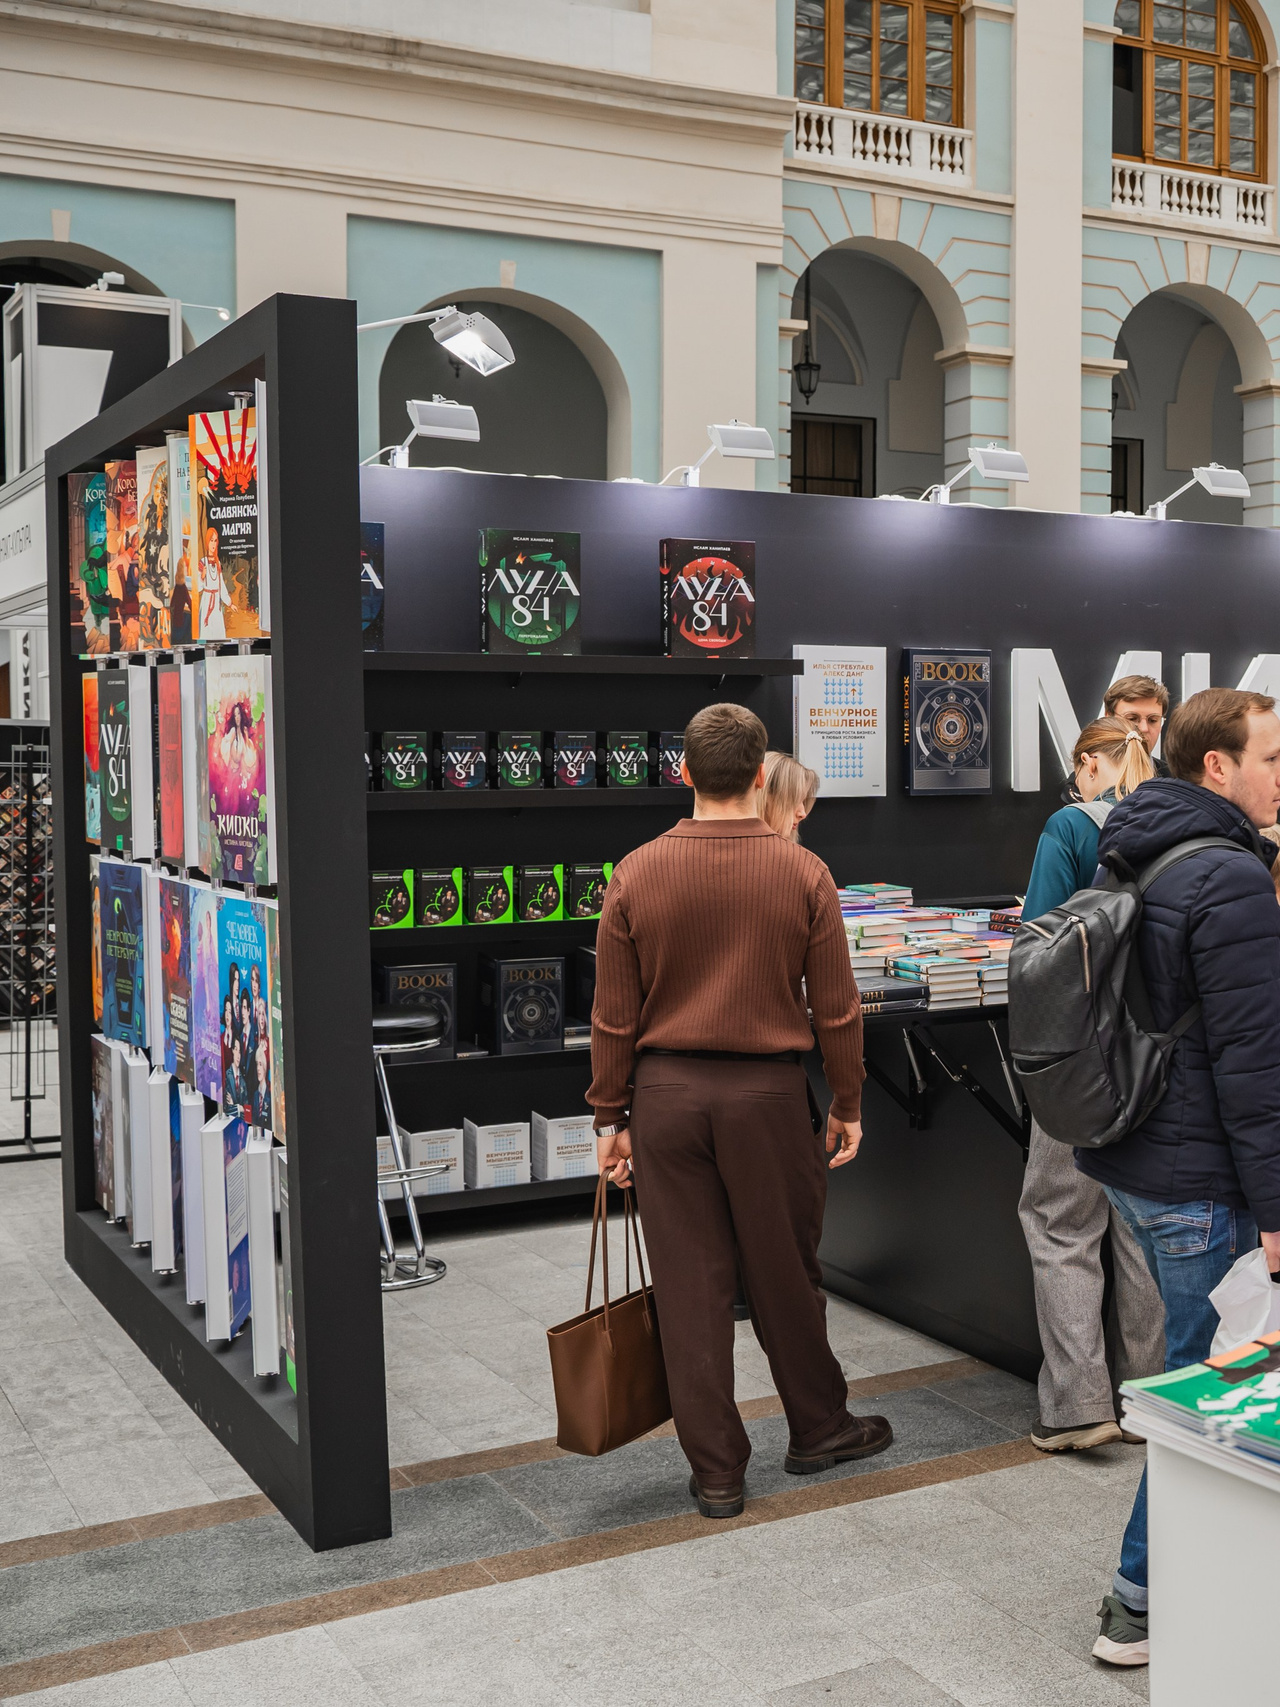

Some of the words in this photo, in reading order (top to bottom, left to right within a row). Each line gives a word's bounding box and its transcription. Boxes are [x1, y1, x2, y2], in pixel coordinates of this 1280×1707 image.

[210, 504, 258, 520] СЛАВЯНСКА
[488, 568, 580, 596] ЛУНА
[670, 576, 755, 602] ЛУНА
[511, 591, 549, 627] 84
[692, 597, 727, 631] 84
[922, 662, 983, 682] BOOK
[809, 708, 878, 717] ВЕНЧУРНОЕ
[809, 719, 878, 728] МЫШЛЕНИЕ
[384, 752, 428, 765] ЛУНА
[444, 751, 487, 764] ЛУНА
[500, 751, 542, 764] ЛУНА
[557, 750, 597, 763] ЛУНА
[610, 750, 649, 763] ЛУНА
[663, 750, 685, 763] ЛУ
[395, 763, 415, 780] 84
[455, 762, 475, 780] 84
[511, 762, 530, 779] 84
[566, 762, 585, 778] 84
[619, 762, 637, 778] 84
[217, 814, 259, 838] КИОКО
[226, 920, 258, 944] ЧЕЛОВЕК
[234, 940, 262, 963] БОРТОМ
[397, 973, 448, 990] BOOK
[508, 966, 556, 983] BOOK
[485, 1150, 524, 1159] ВЕНЧУРНОЕ
[556, 1142, 593, 1151] ВЕНЧУРНОЕ
[556, 1147, 593, 1156] МЫШЛЕНИЕ
[419, 1157, 458, 1166] ВЕНЧУРНОЕ
[485, 1155, 524, 1163] МЫШЛЕНИЕ
